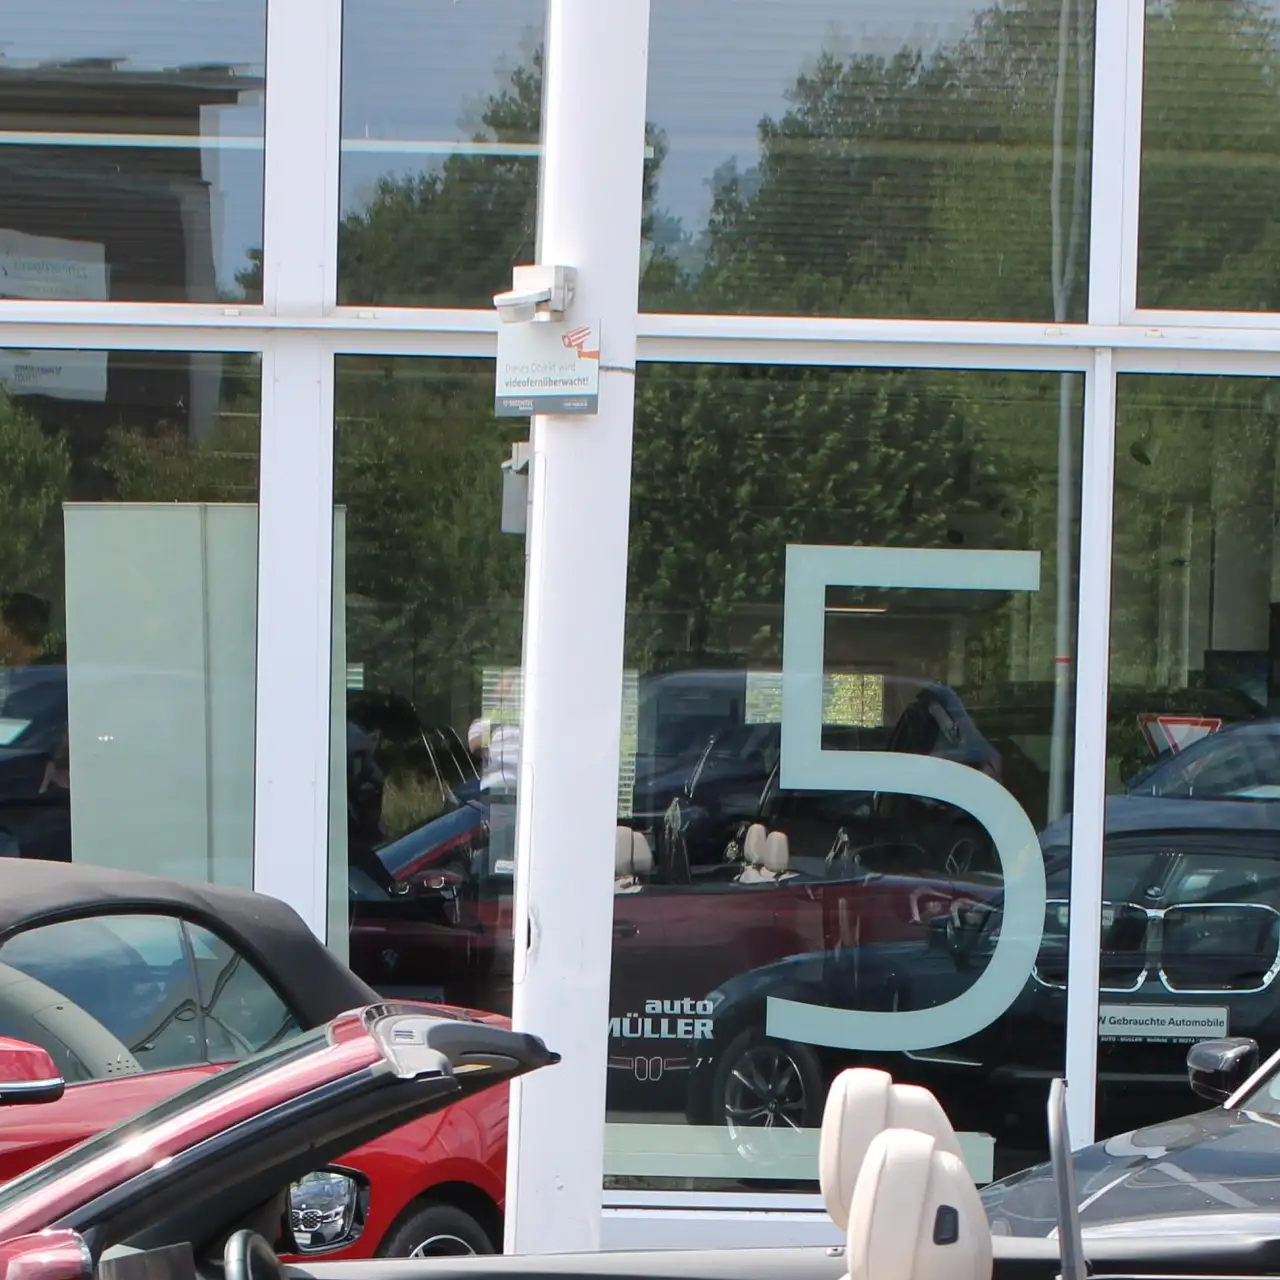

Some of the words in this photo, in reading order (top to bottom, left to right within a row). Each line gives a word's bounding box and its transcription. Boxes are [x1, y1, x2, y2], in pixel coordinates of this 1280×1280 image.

[504, 376, 589, 389] videofernüberwacht!
[766, 544, 1047, 1052] 5
[645, 997, 714, 1015] auto
[1109, 1015, 1166, 1027] Gebrauchte
[1168, 1016, 1225, 1028] Automobile
